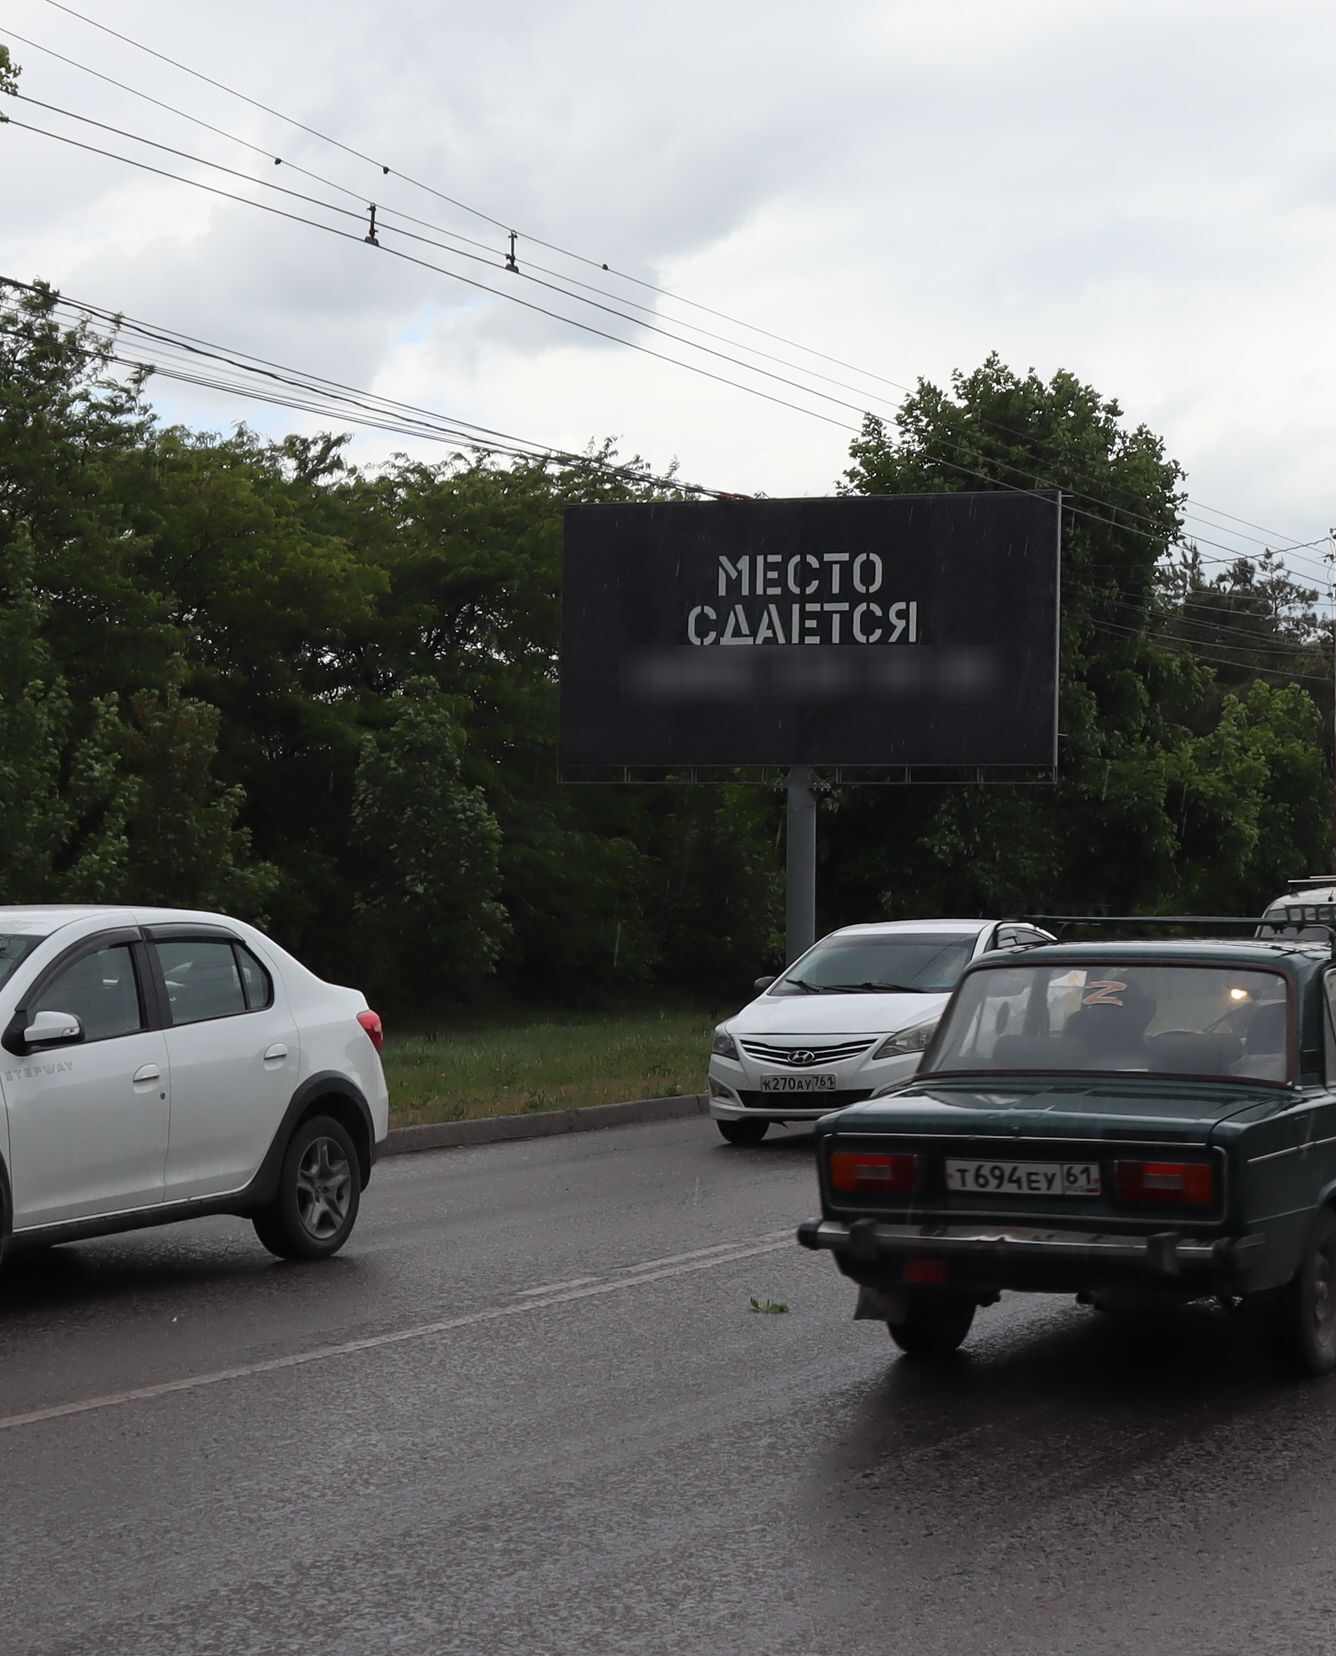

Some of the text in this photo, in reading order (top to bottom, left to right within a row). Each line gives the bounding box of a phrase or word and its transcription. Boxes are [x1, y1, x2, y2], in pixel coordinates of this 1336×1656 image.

[718, 552, 883, 596] МЕСТО
[688, 601, 917, 645] СДАЕТСЯ
[955, 1164, 1092, 1191] Т694ЕУ 61
